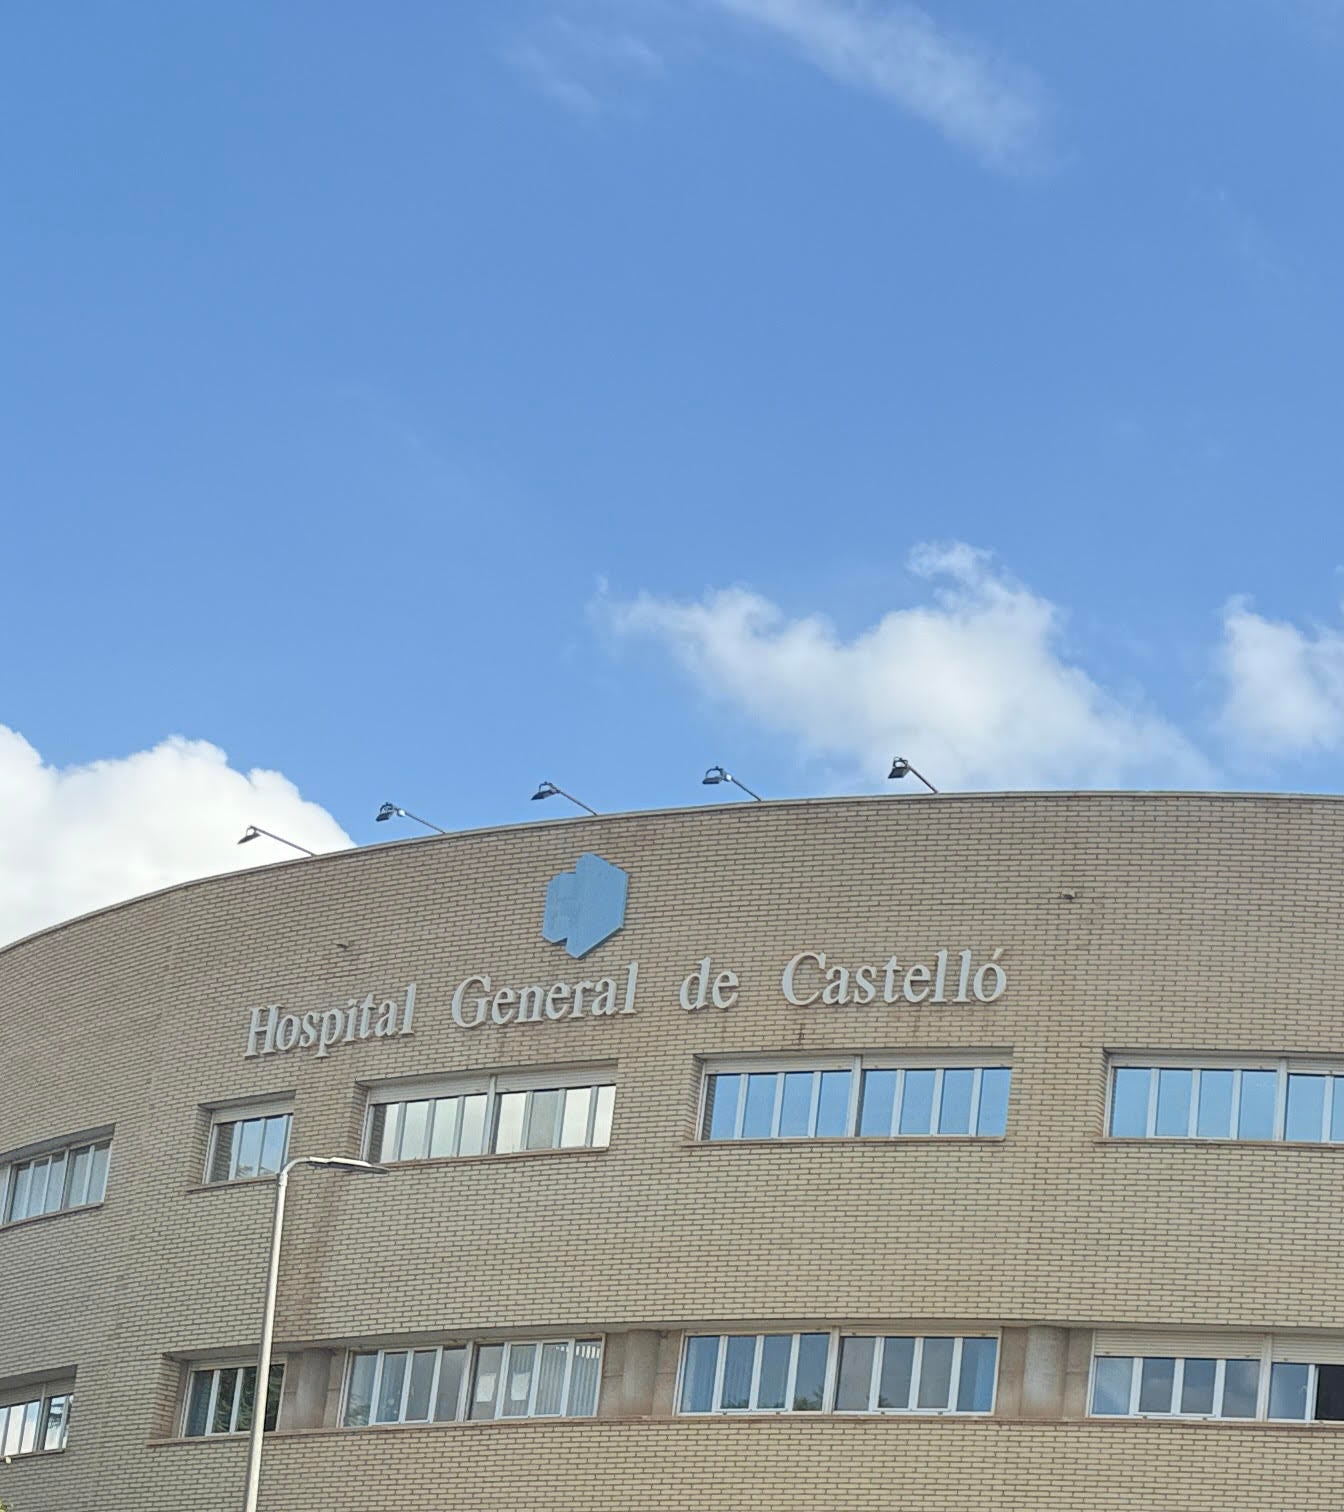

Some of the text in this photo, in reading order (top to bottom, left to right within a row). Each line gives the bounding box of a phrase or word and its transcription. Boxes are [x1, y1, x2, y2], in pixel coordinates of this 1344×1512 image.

[244, 948, 1008, 1059] Hospital General de Castelló
